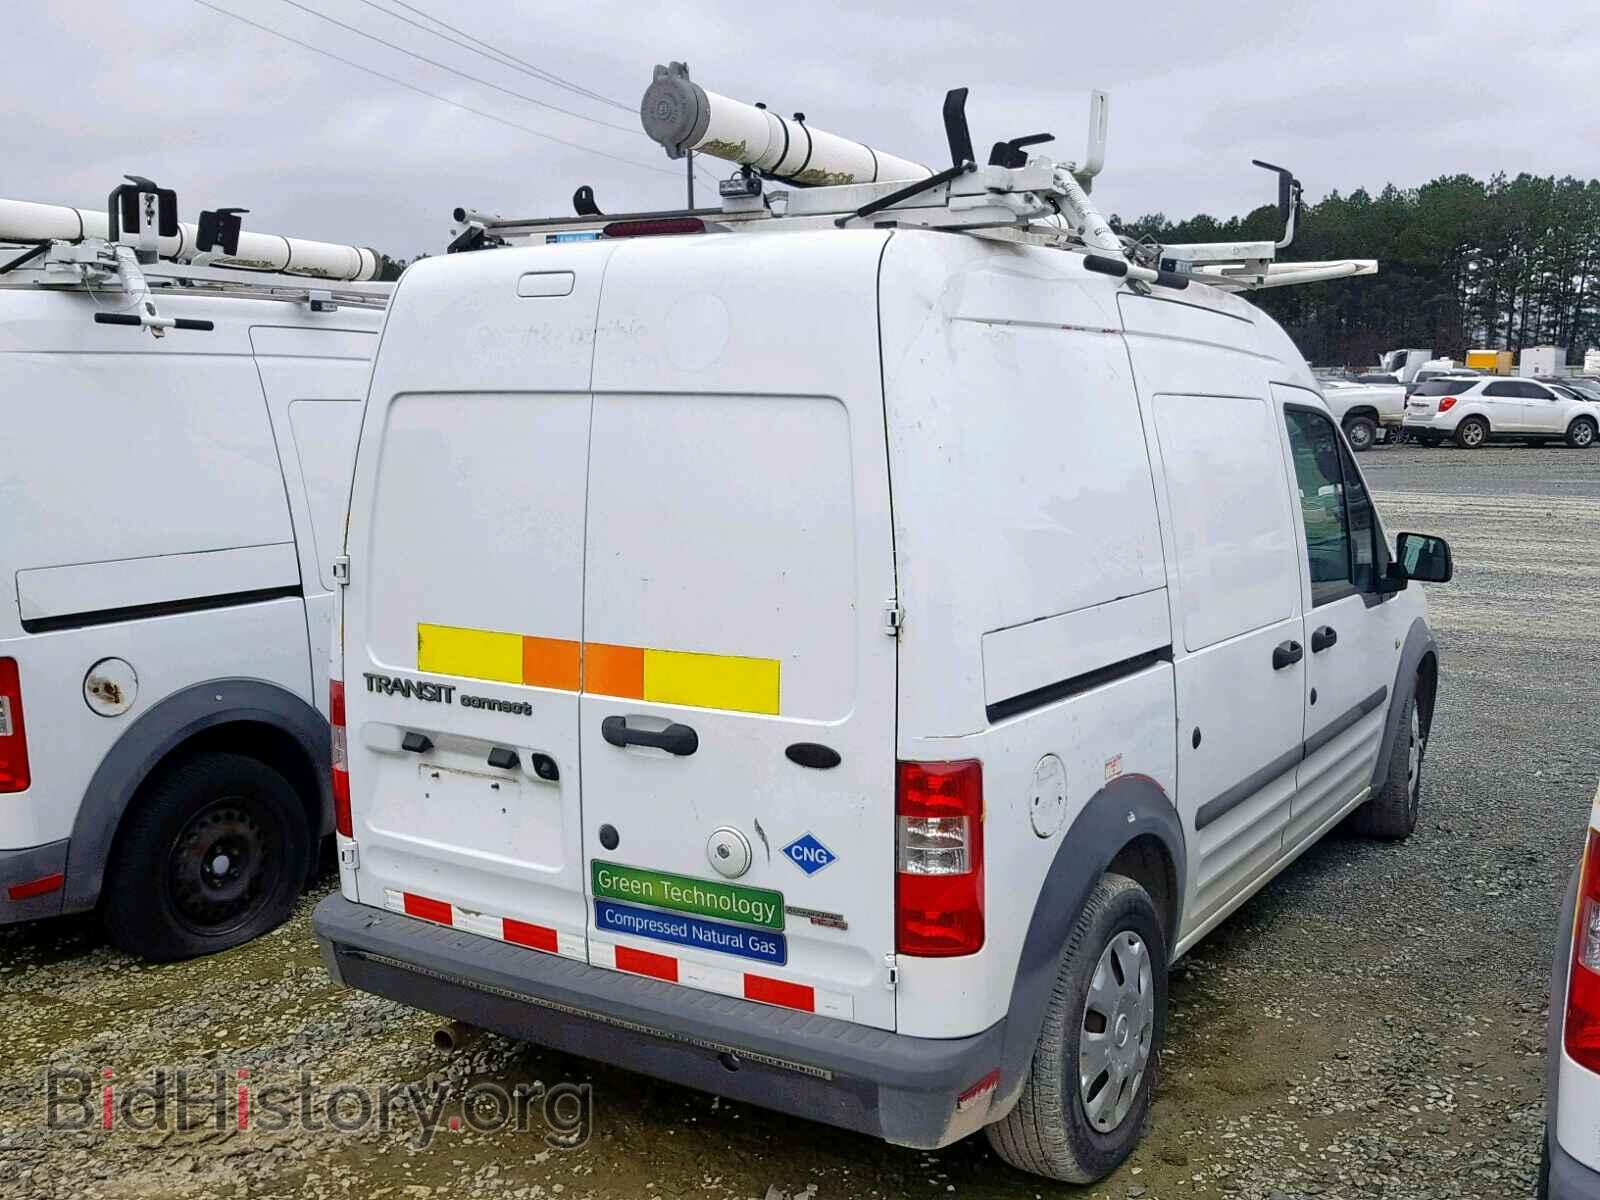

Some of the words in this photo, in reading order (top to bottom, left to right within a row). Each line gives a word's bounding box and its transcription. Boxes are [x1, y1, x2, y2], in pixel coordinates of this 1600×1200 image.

[363, 672, 456, 704] TRANSIT
[460, 694, 533, 716] connect
[791, 845, 828, 864] CNG
[598, 869, 653, 897] Green
[660, 880, 776, 924] Technology
[605, 908, 688, 937] Compressed
[692, 927, 744, 949] Natural
[748, 936, 777, 954] Gas
